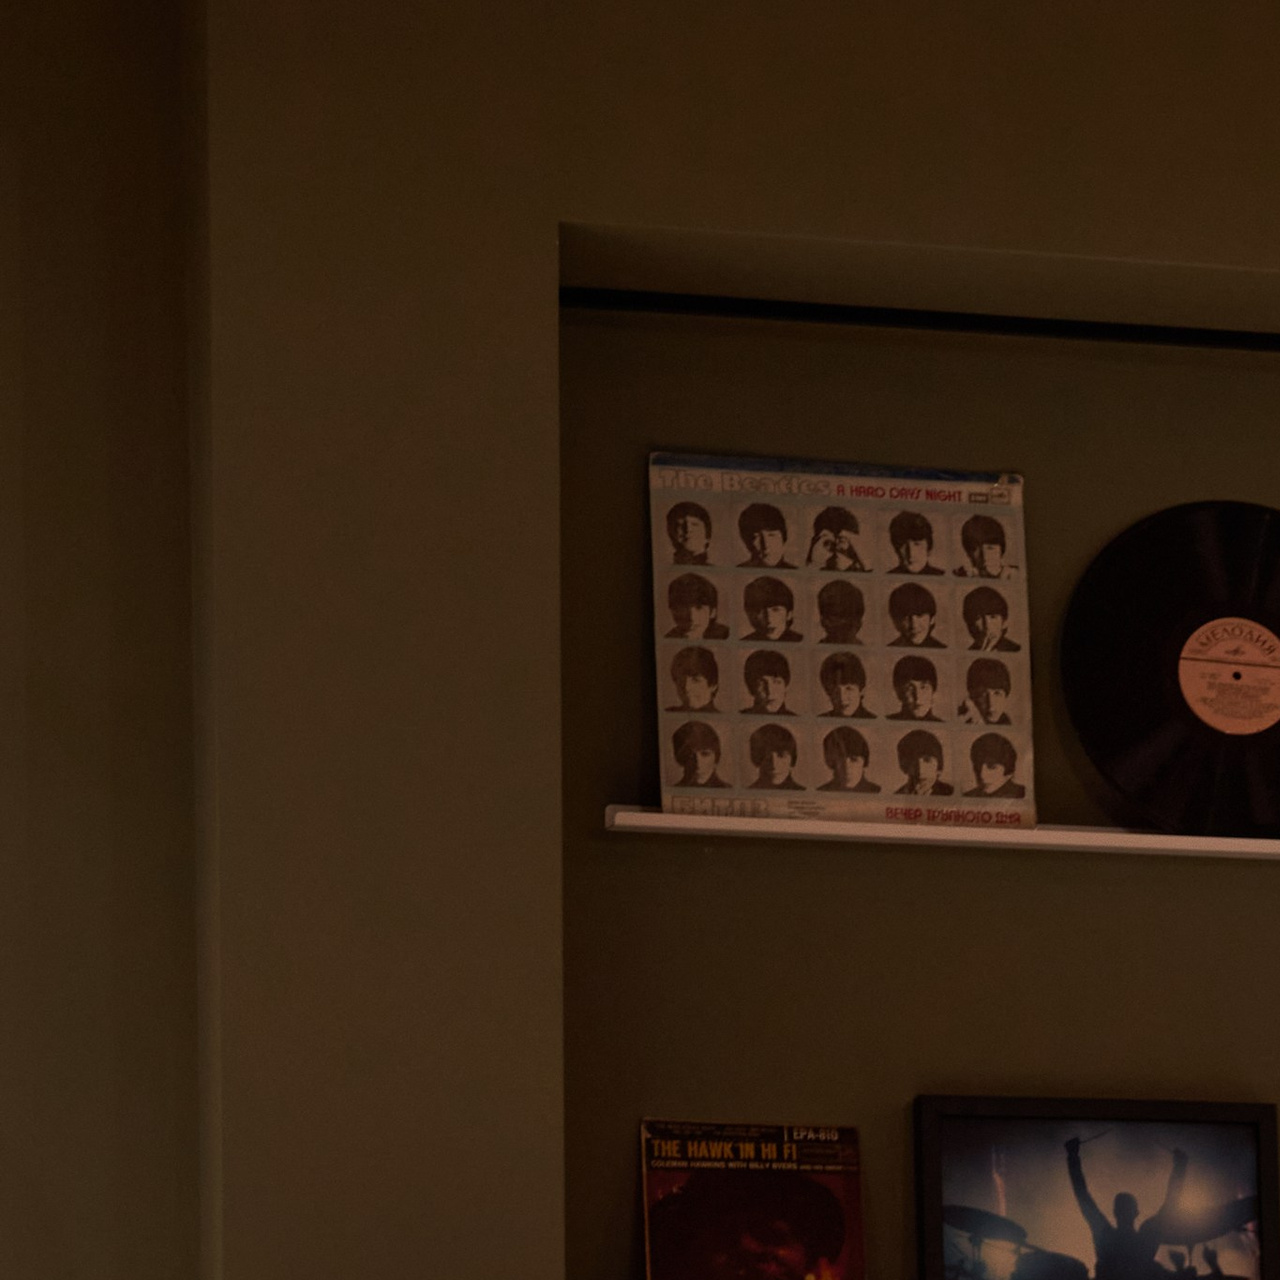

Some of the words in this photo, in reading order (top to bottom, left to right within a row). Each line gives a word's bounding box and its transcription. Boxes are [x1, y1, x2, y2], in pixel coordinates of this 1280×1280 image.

[837, 485, 846, 496] A
[850, 486, 886, 498] HARD
[925, 489, 962, 502] NIGHT
[885, 807, 922, 821] ВЕЧЕР
[651, 1139, 682, 1158] THE
[687, 1141, 735, 1159] HAWK
[738, 1142, 756, 1160] IN
[761, 1143, 778, 1160] HI
[783, 1143, 798, 1161] FI
